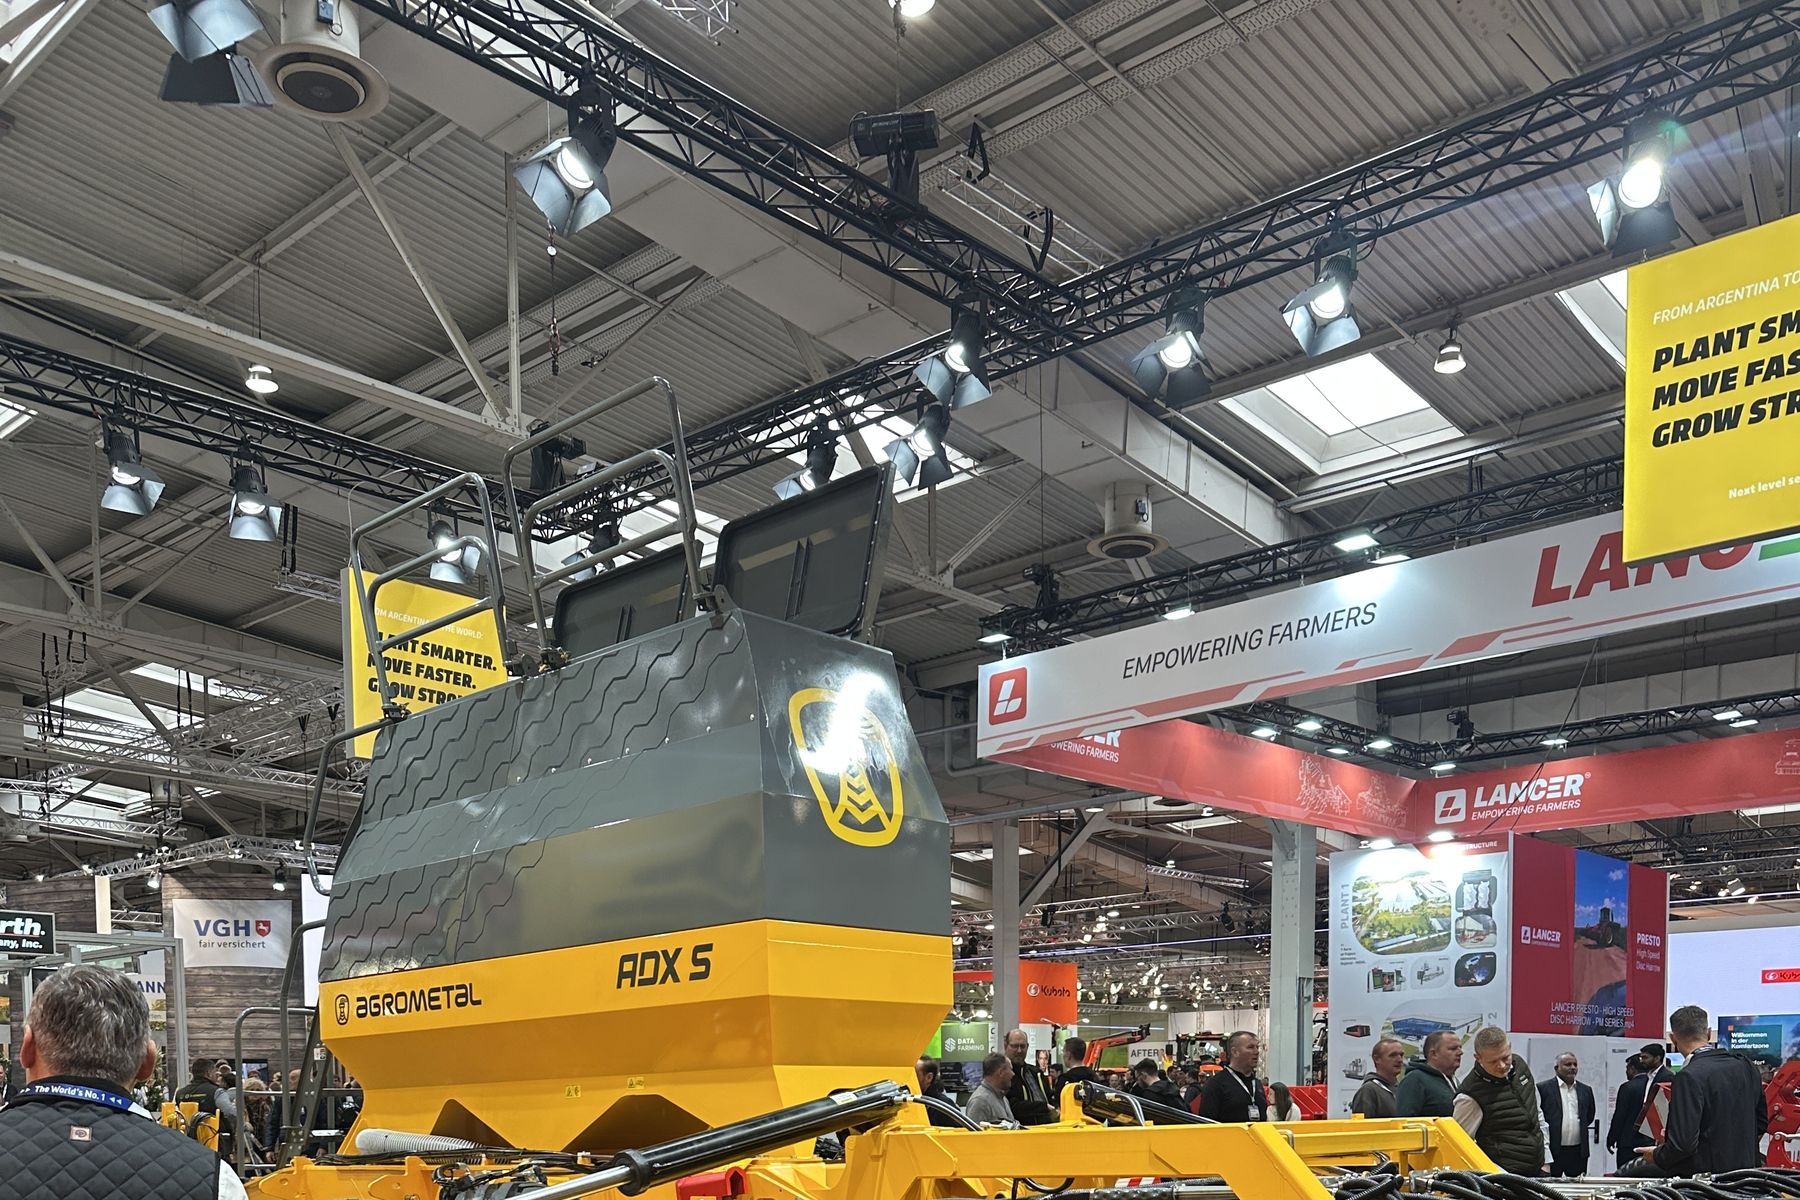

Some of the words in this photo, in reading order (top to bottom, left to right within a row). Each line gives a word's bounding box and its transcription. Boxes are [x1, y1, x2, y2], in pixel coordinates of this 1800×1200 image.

[1653, 302, 1693, 325] FROM
[1695, 277, 1780, 312] ARGENTINA
[1652, 322, 1756, 374] PLANT
[1652, 366, 1739, 411] MOVE
[1652, 403, 1744, 448] GROW
[1728, 488, 1756, 499] Next
[1758, 476, 1786, 492] level
[1122, 629, 1263, 679] EMPOWERING
[1268, 602, 1377, 647] FARMERS
[420, 642, 497, 671] SMARTER.
[415, 663, 476, 689] FASTER.
[1086, 746, 1119, 763] FARMERS
[1473, 773, 1584, 808] LANCER
[1471, 804, 1534, 821] EMPOWERING
[1535, 799, 1581, 812] FARMERS
[1340, 892, 1349, 929] PLANT
[193, 919, 250, 937] VGH
[1533, 928, 1560, 942] LANCER
[22, 939, 43, 949] Inc.
[199, 940, 215, 948] fair
[217, 940, 266, 948] versichert
[1637, 932, 1660, 947] PRESTO
[616, 947, 683, 989] ADX
[689, 943, 714, 981] S
[1041, 984, 1070, 997] Kubota
[1550, 1014, 1564, 1024] DISC
[1551, 1002, 1575, 1012] LANCER
[1577, 1003, 1599, 1014] PRESTO
[1603, 1006, 1616, 1015] HIGH
[1617, 1007, 1634, 1017] SPEED
[35, 1085, 49, 1093] The
[51, 1085, 83, 1097] World's
[84, 1090, 99, 1100] No.
